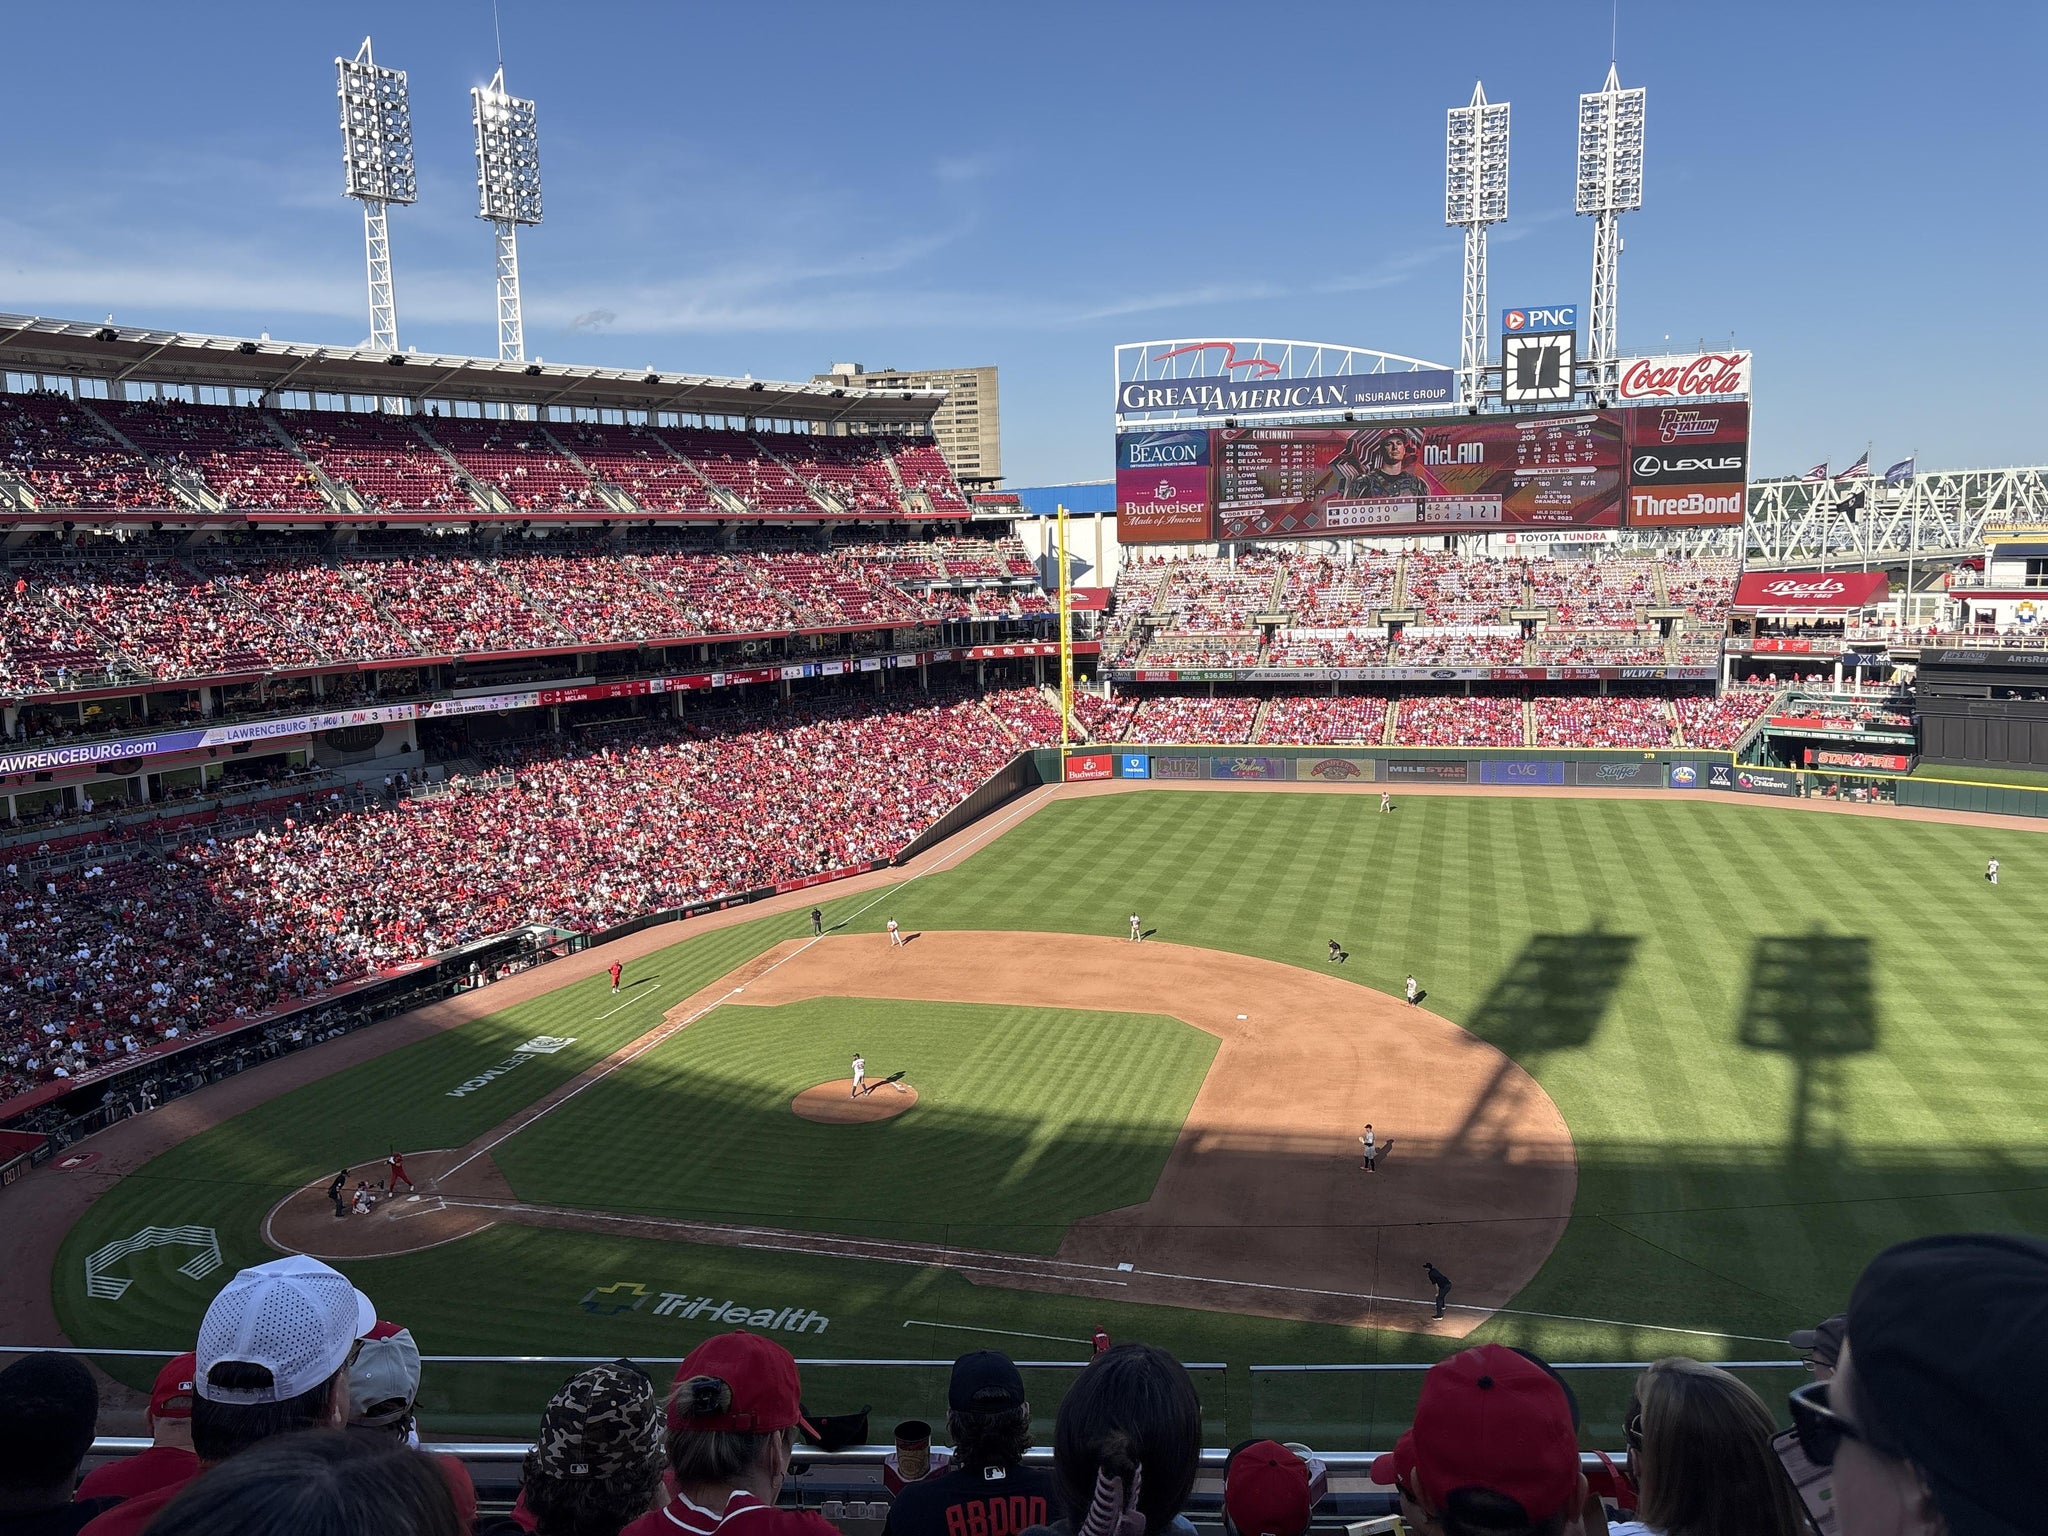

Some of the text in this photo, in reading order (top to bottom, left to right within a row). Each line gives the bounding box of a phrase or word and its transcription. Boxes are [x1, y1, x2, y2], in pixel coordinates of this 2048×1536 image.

[1528, 308, 1574, 327] PNC
[1620, 354, 1749, 398] Coca-Cola
[1355, 391, 1410, 402] INSURANCE
[1413, 388, 1446, 400] GROUP
[1659, 409, 1700, 430] PENN
[1252, 430, 1294, 439] CINCINNATI
[1661, 419, 1719, 442] STATION
[1130, 444, 1197, 463] BEACON
[1663, 456, 1742, 471] LEXUS
[1125, 501, 1204, 515] Budweiser
[1470, 506, 1496, 517] 1 2 1
[1632, 492, 1741, 516] ThreeBond
[1124, 514, 1201, 526] Made of America
[1520, 532, 1606, 542] TOYOTA TUNDRA
[1762, 579, 1845, 596] Reds
[227, 721, 306, 740] LAWRENCEBURG
[372, 712, 378, 720] 3
[1231, 758, 1266, 772] Skyline
[1508, 764, 1536, 775] CVG
[1596, 765, 1640, 780] Swiffer
[1069, 770, 1110, 779] Budweiser
[1753, 780, 1788, 789] Children's
[445, 1053, 536, 1097] BETMGM
[652, 1292, 829, 1334] TriHealth
